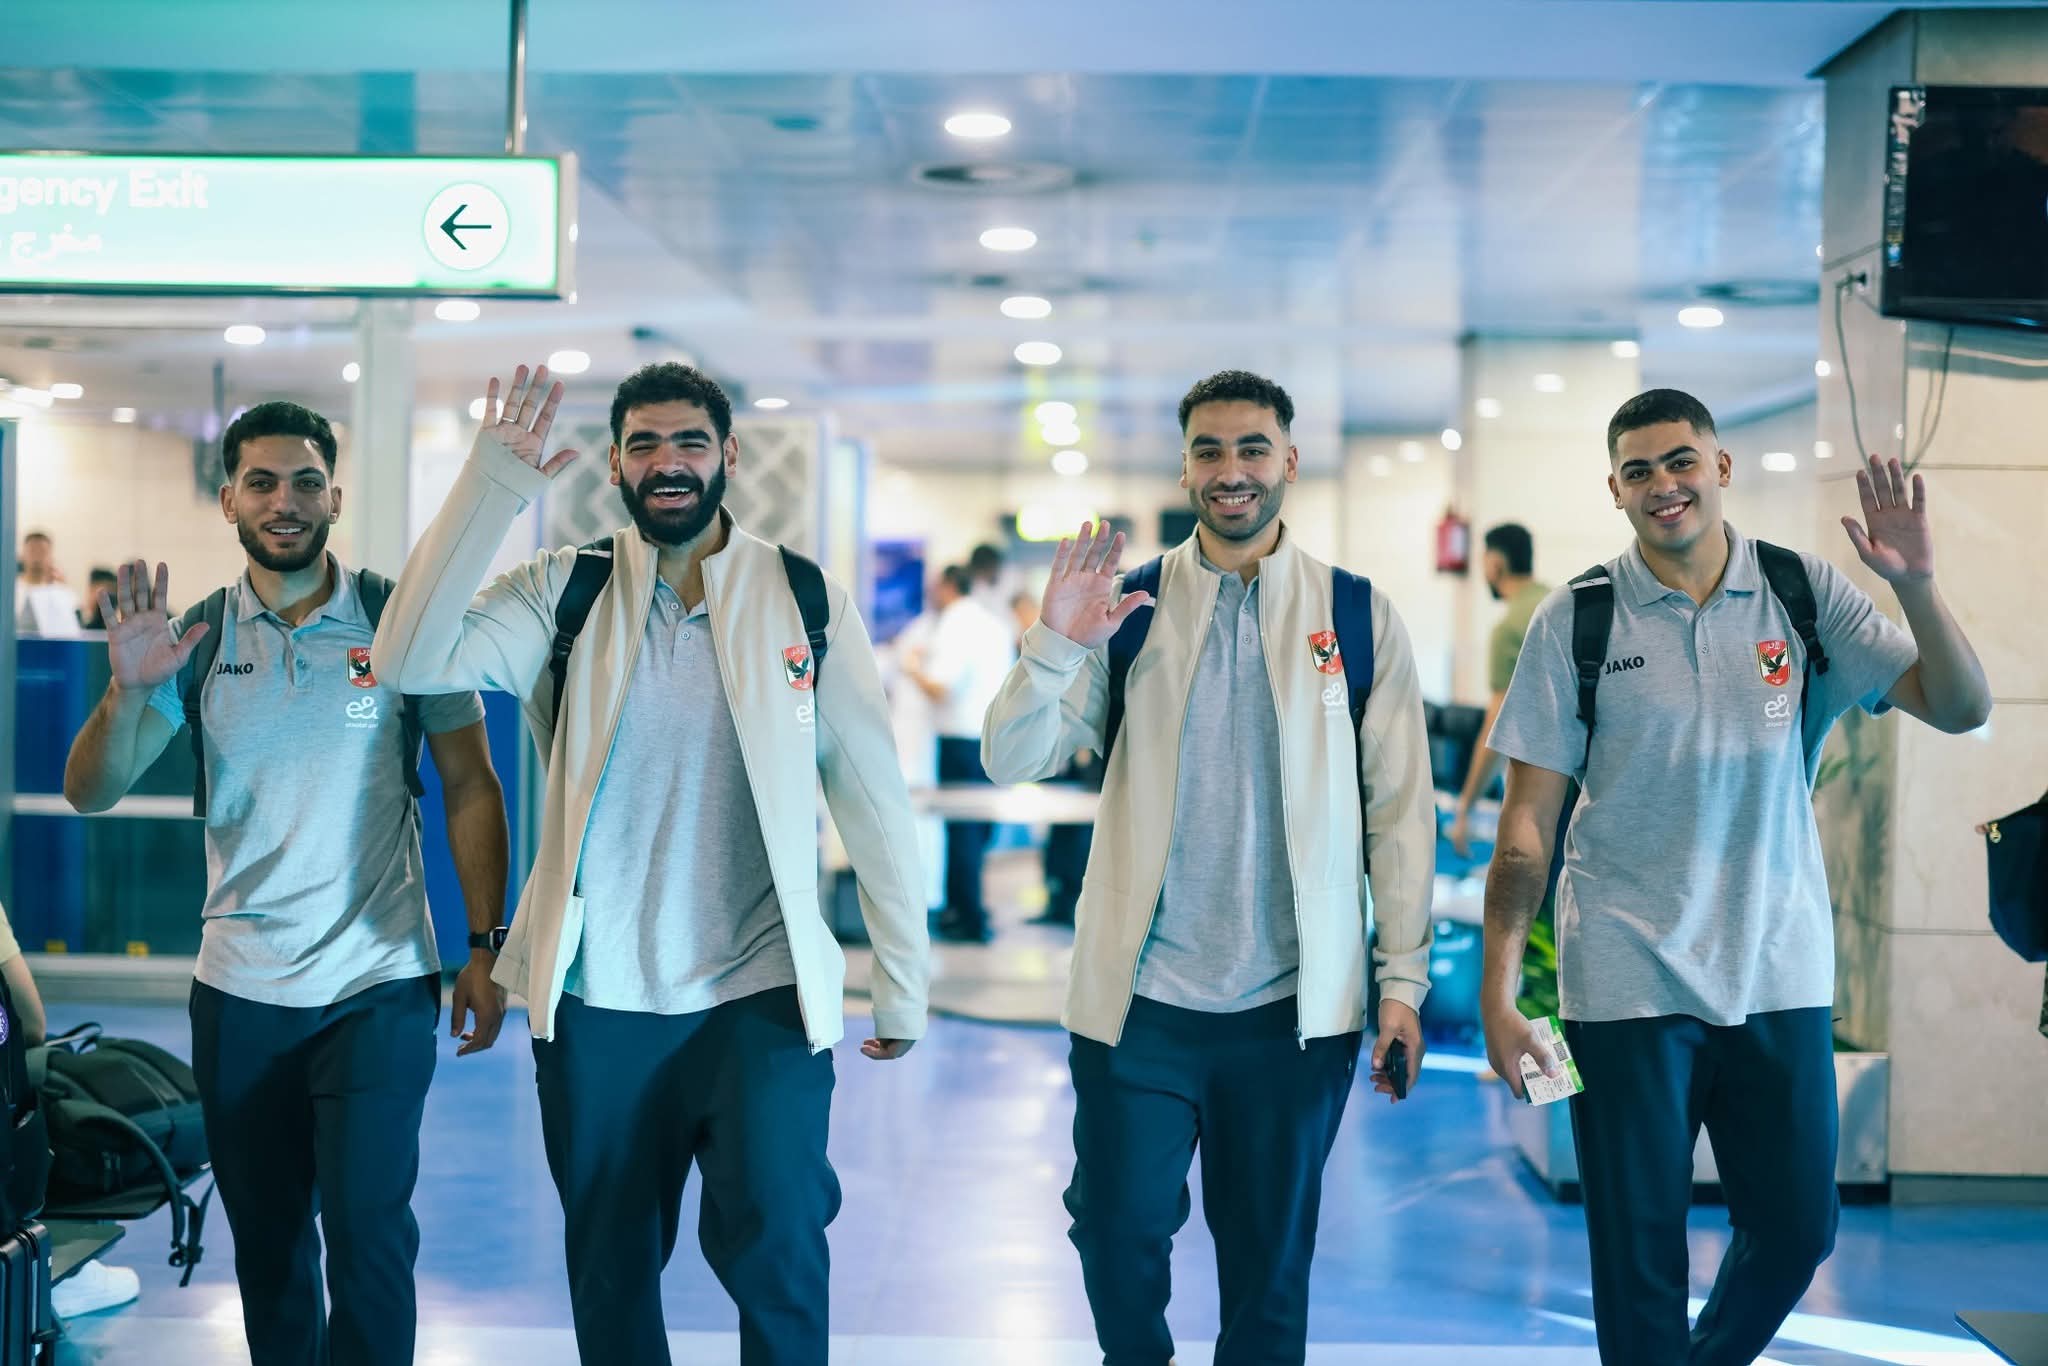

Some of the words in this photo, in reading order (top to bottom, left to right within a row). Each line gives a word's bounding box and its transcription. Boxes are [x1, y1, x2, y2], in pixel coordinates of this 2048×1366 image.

[128, 166, 209, 209] Exit
[216, 662, 254, 676] JAKO
[1605, 655, 1645, 675] JAKO
[345, 695, 379, 720] e&
[1764, 694, 1791, 719] e&
